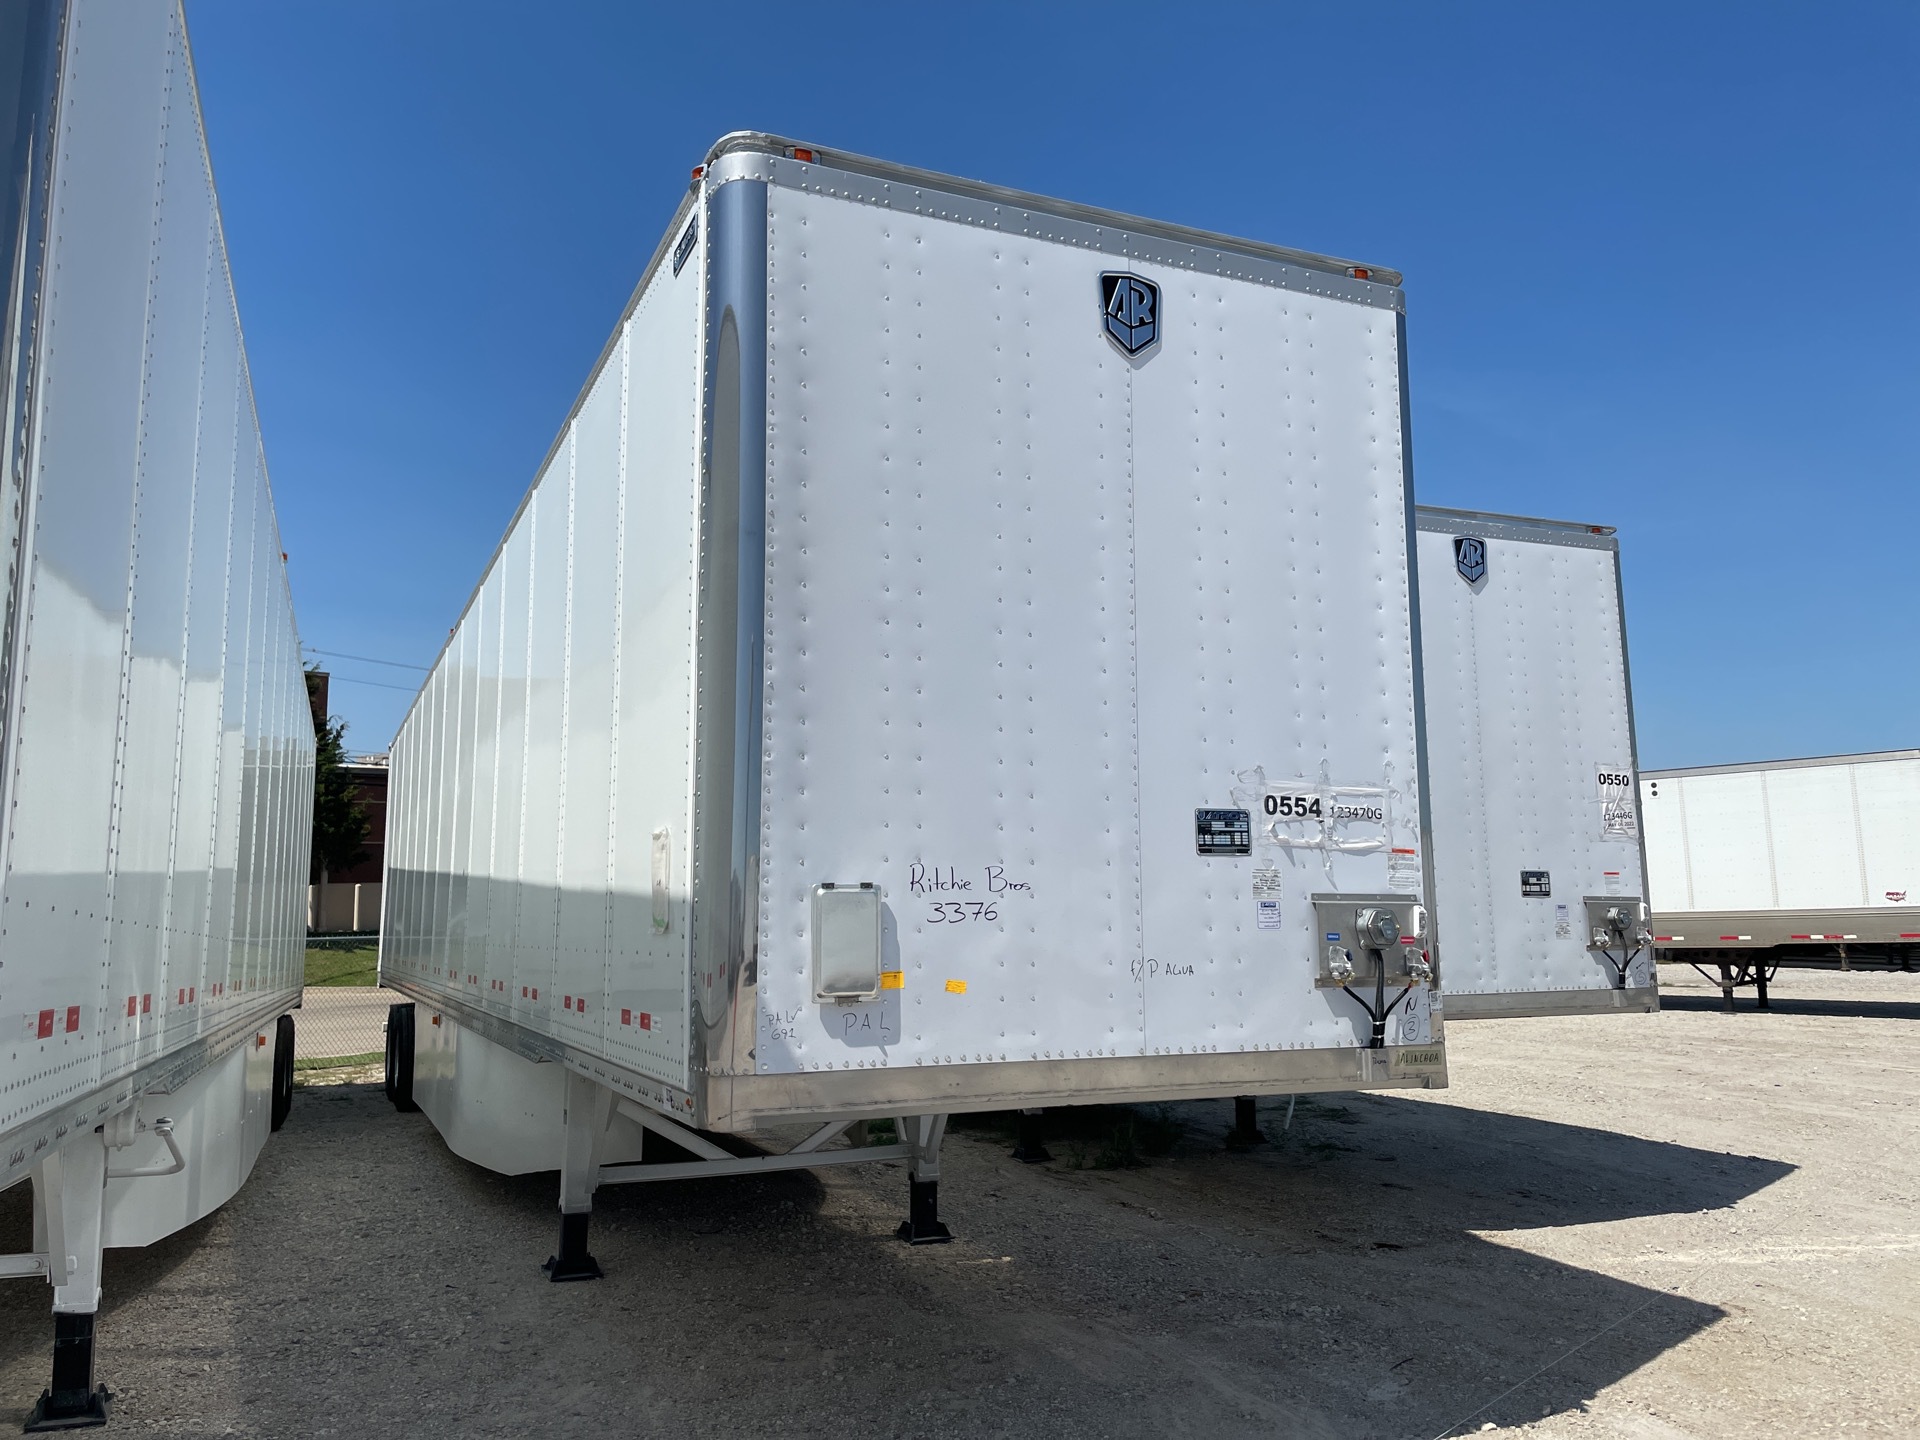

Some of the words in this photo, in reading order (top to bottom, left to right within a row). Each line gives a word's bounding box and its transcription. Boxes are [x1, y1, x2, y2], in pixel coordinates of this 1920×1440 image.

[1598, 773, 1629, 786] 0550
[1264, 795, 1321, 817] 0554
[1330, 807, 1383, 819] 123470G
[910, 863, 972, 892] Ritchie
[985, 866, 1031, 892] Bros
[927, 902, 997, 923] 3376
